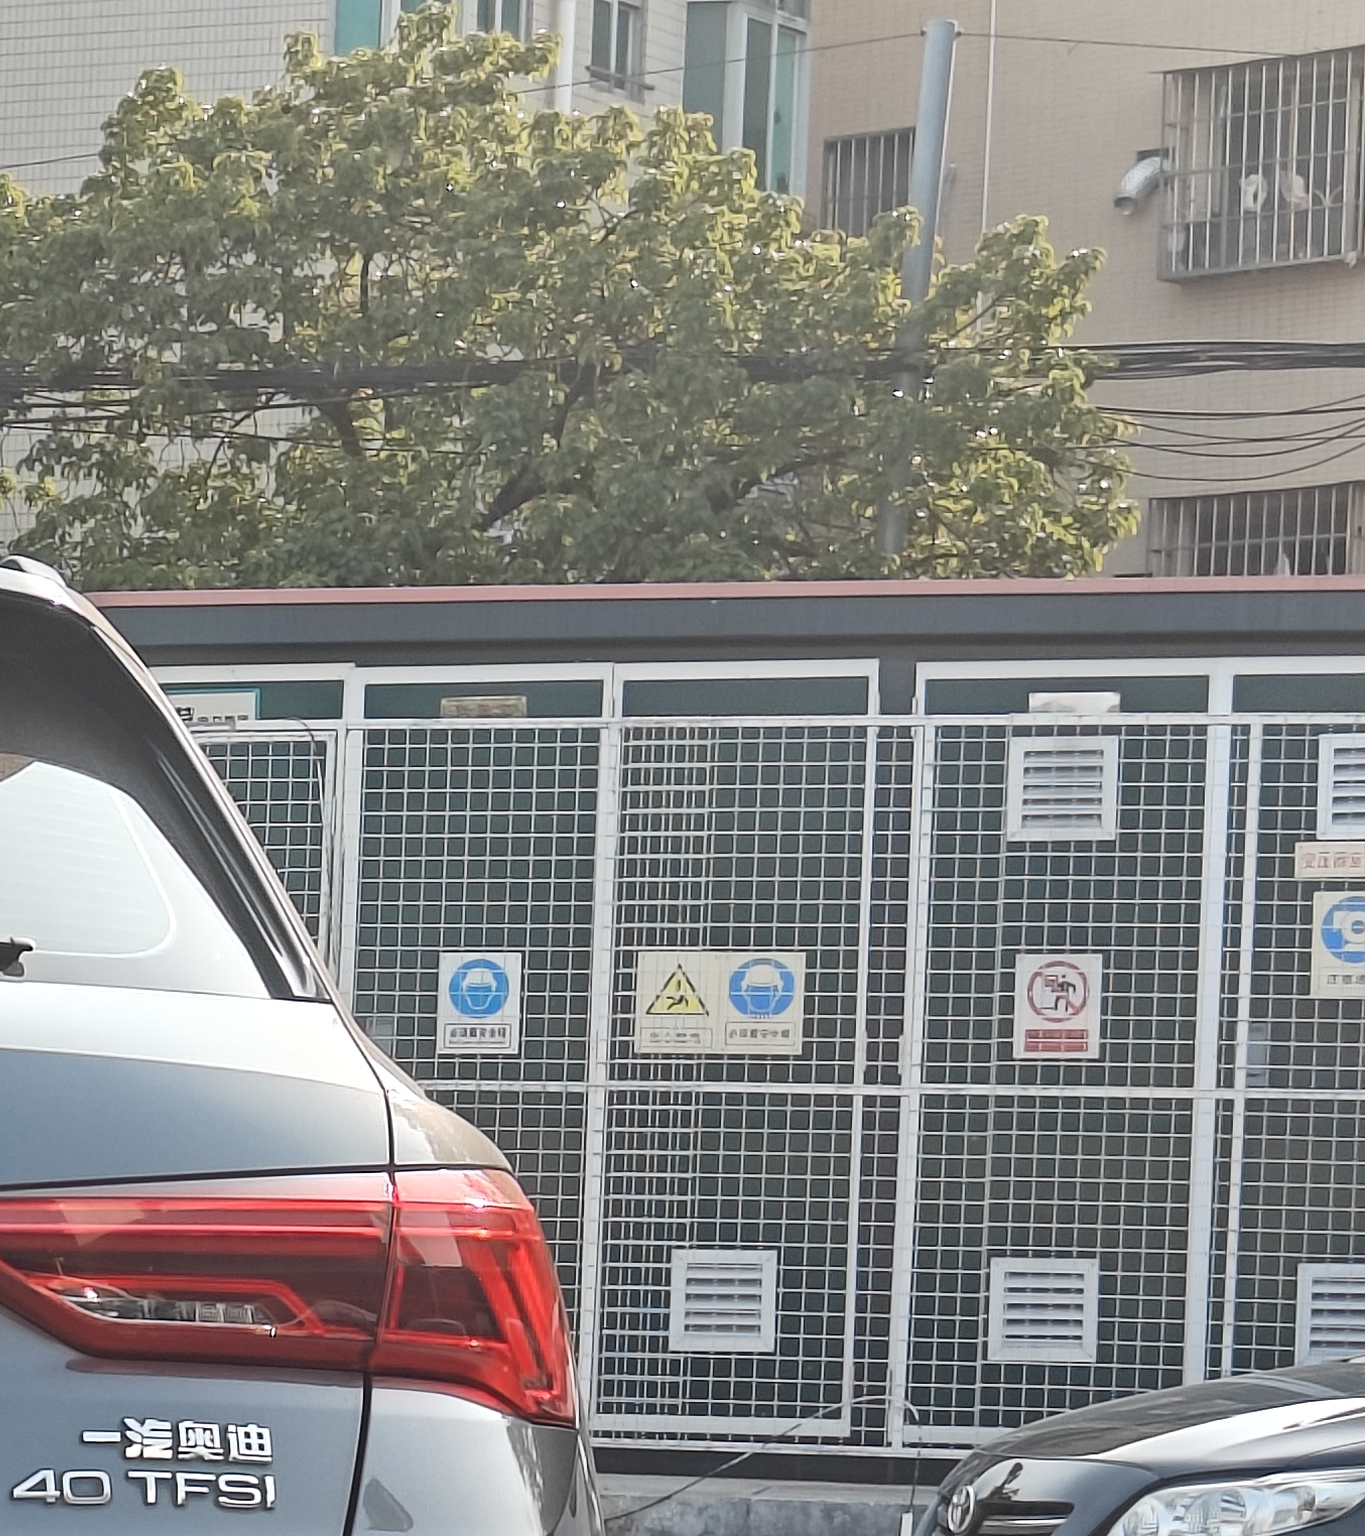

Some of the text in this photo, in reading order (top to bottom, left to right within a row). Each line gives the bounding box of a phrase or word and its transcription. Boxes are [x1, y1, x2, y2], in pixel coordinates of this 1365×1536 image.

[82, 1417, 273, 1463] 一汽奥迪
[11, 1468, 276, 1509] 40 TFSI
